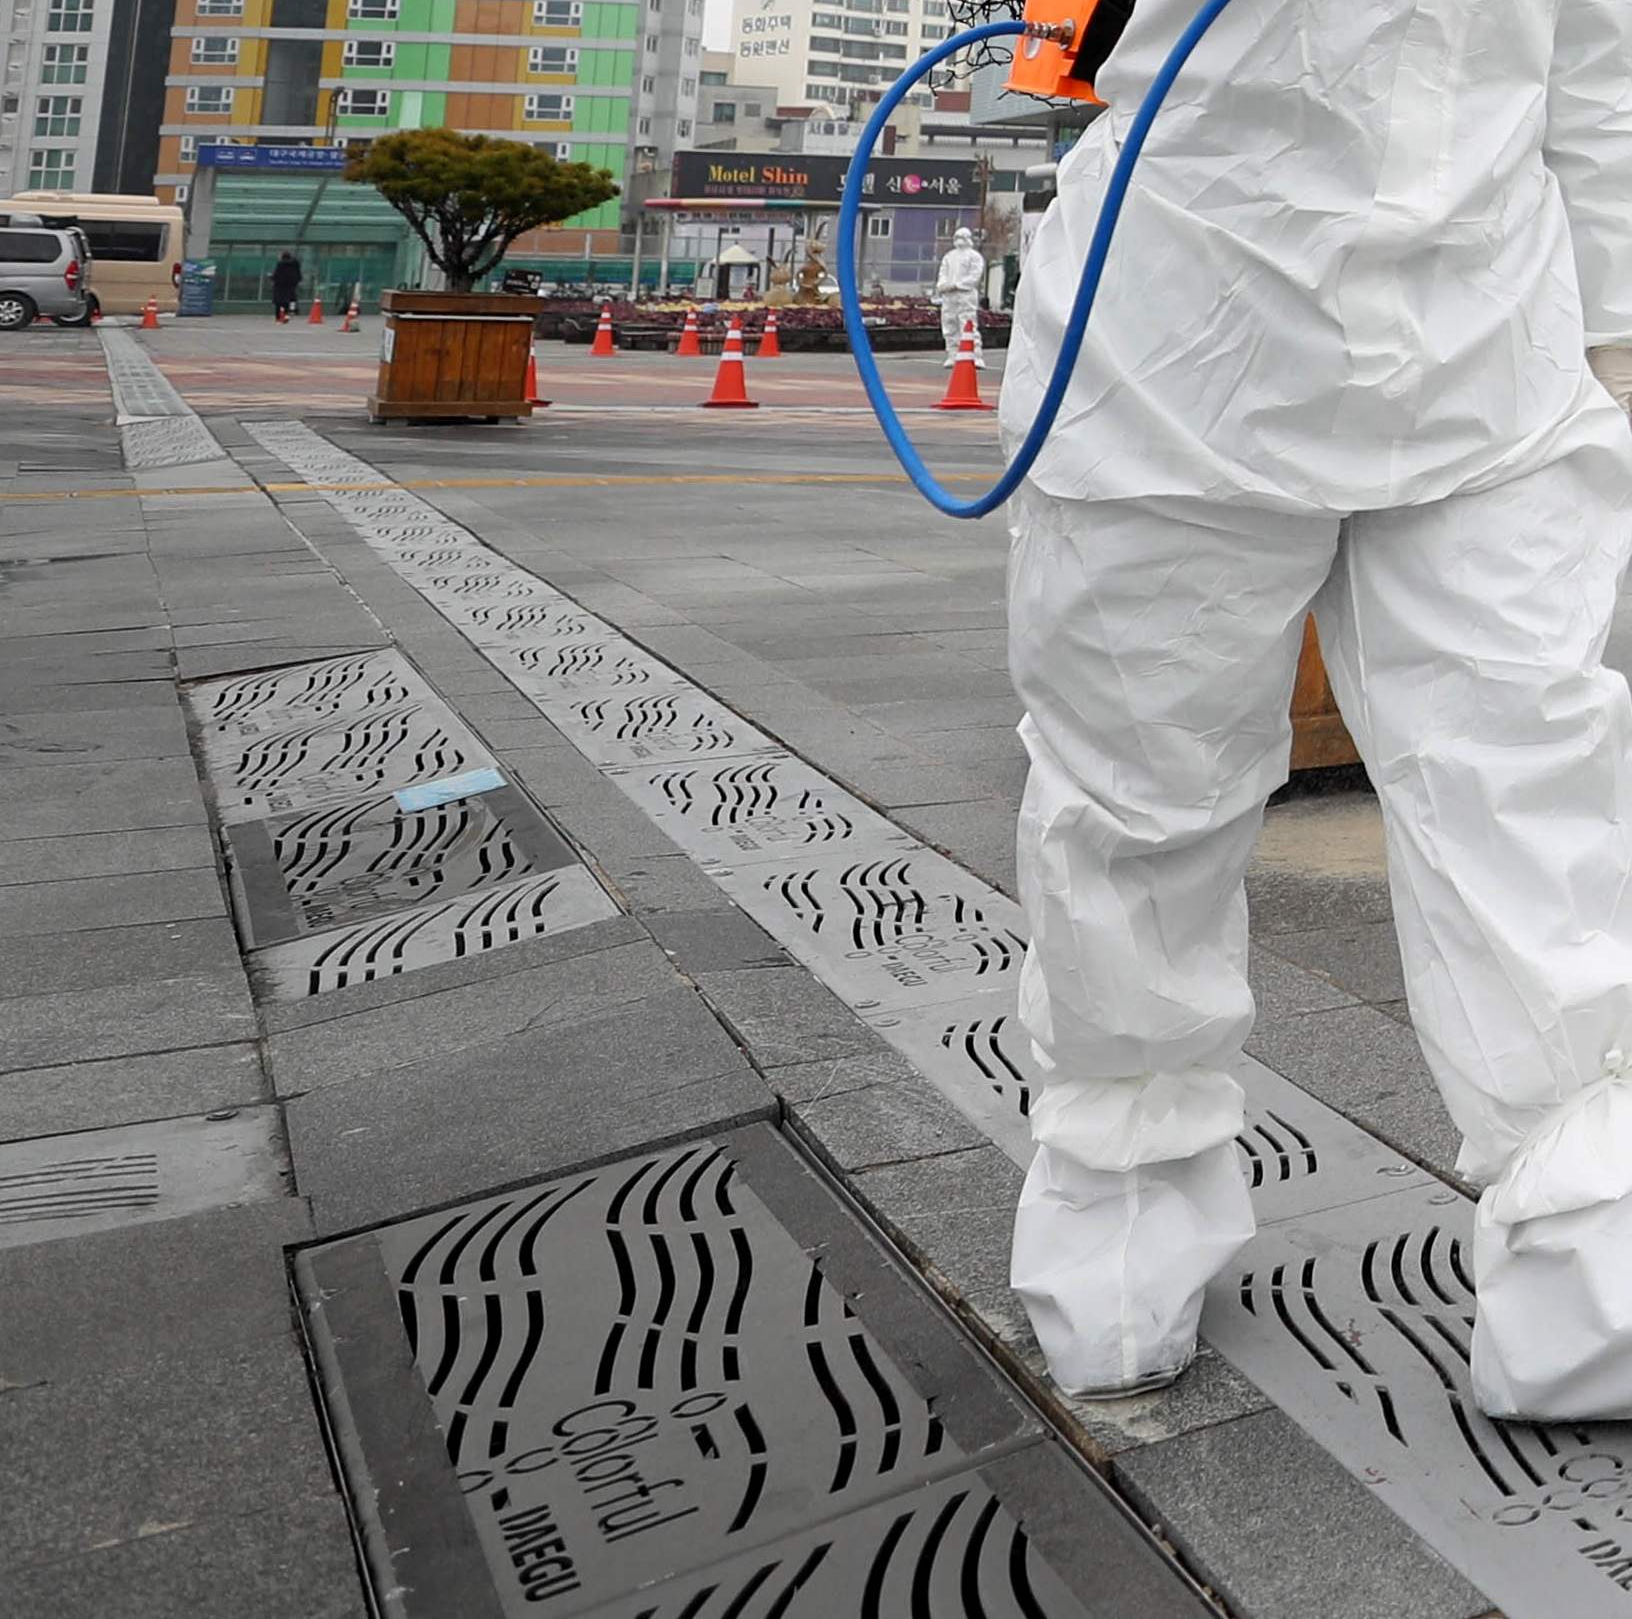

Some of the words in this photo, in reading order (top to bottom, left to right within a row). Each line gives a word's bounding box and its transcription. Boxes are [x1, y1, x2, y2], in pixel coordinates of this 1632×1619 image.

[707, 165, 755, 183] Motel
[761, 166, 809, 184] Shin
[552, 1400, 699, 1543] Colorful
[498, 1504, 581, 1602] DAEGU
